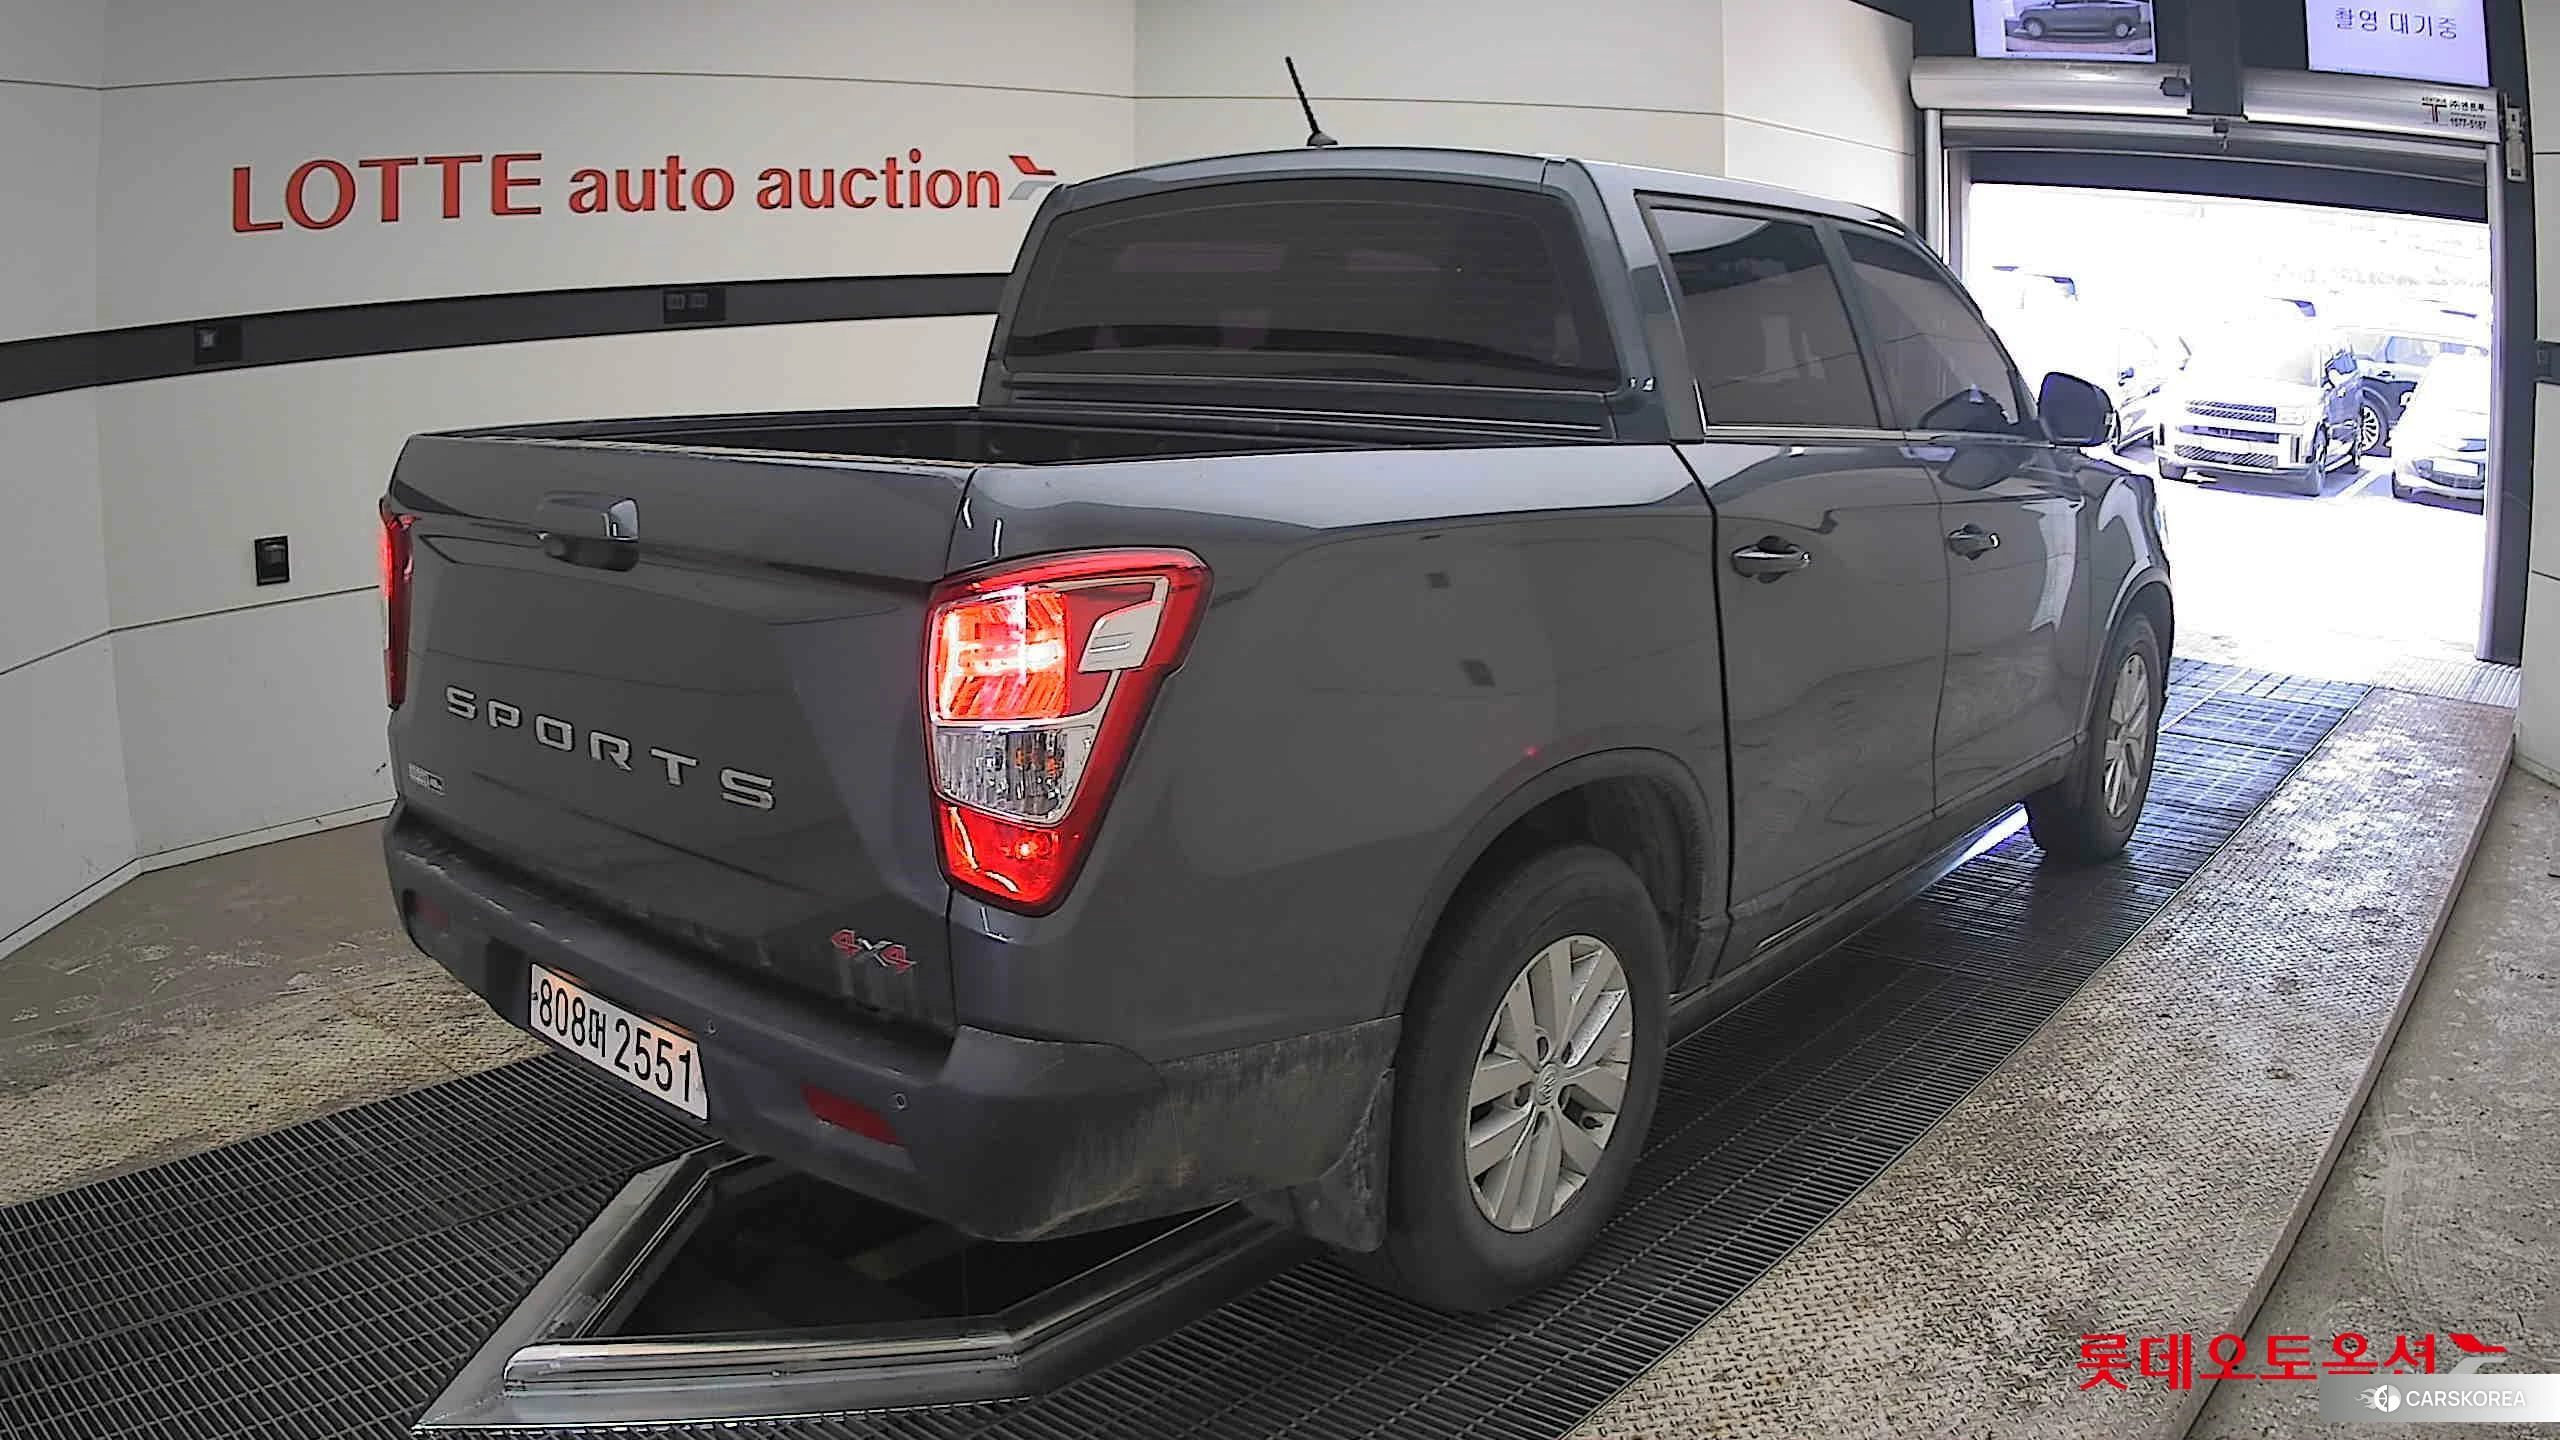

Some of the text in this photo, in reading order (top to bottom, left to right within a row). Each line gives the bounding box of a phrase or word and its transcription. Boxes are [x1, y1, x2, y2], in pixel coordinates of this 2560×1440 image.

[2389, 11, 2457, 40] 대기중
[232, 147, 1001, 232] LOTTE auto auction
[445, 686, 776, 811] SPORTS
[539, 978, 691, 1103] 808머 2551
